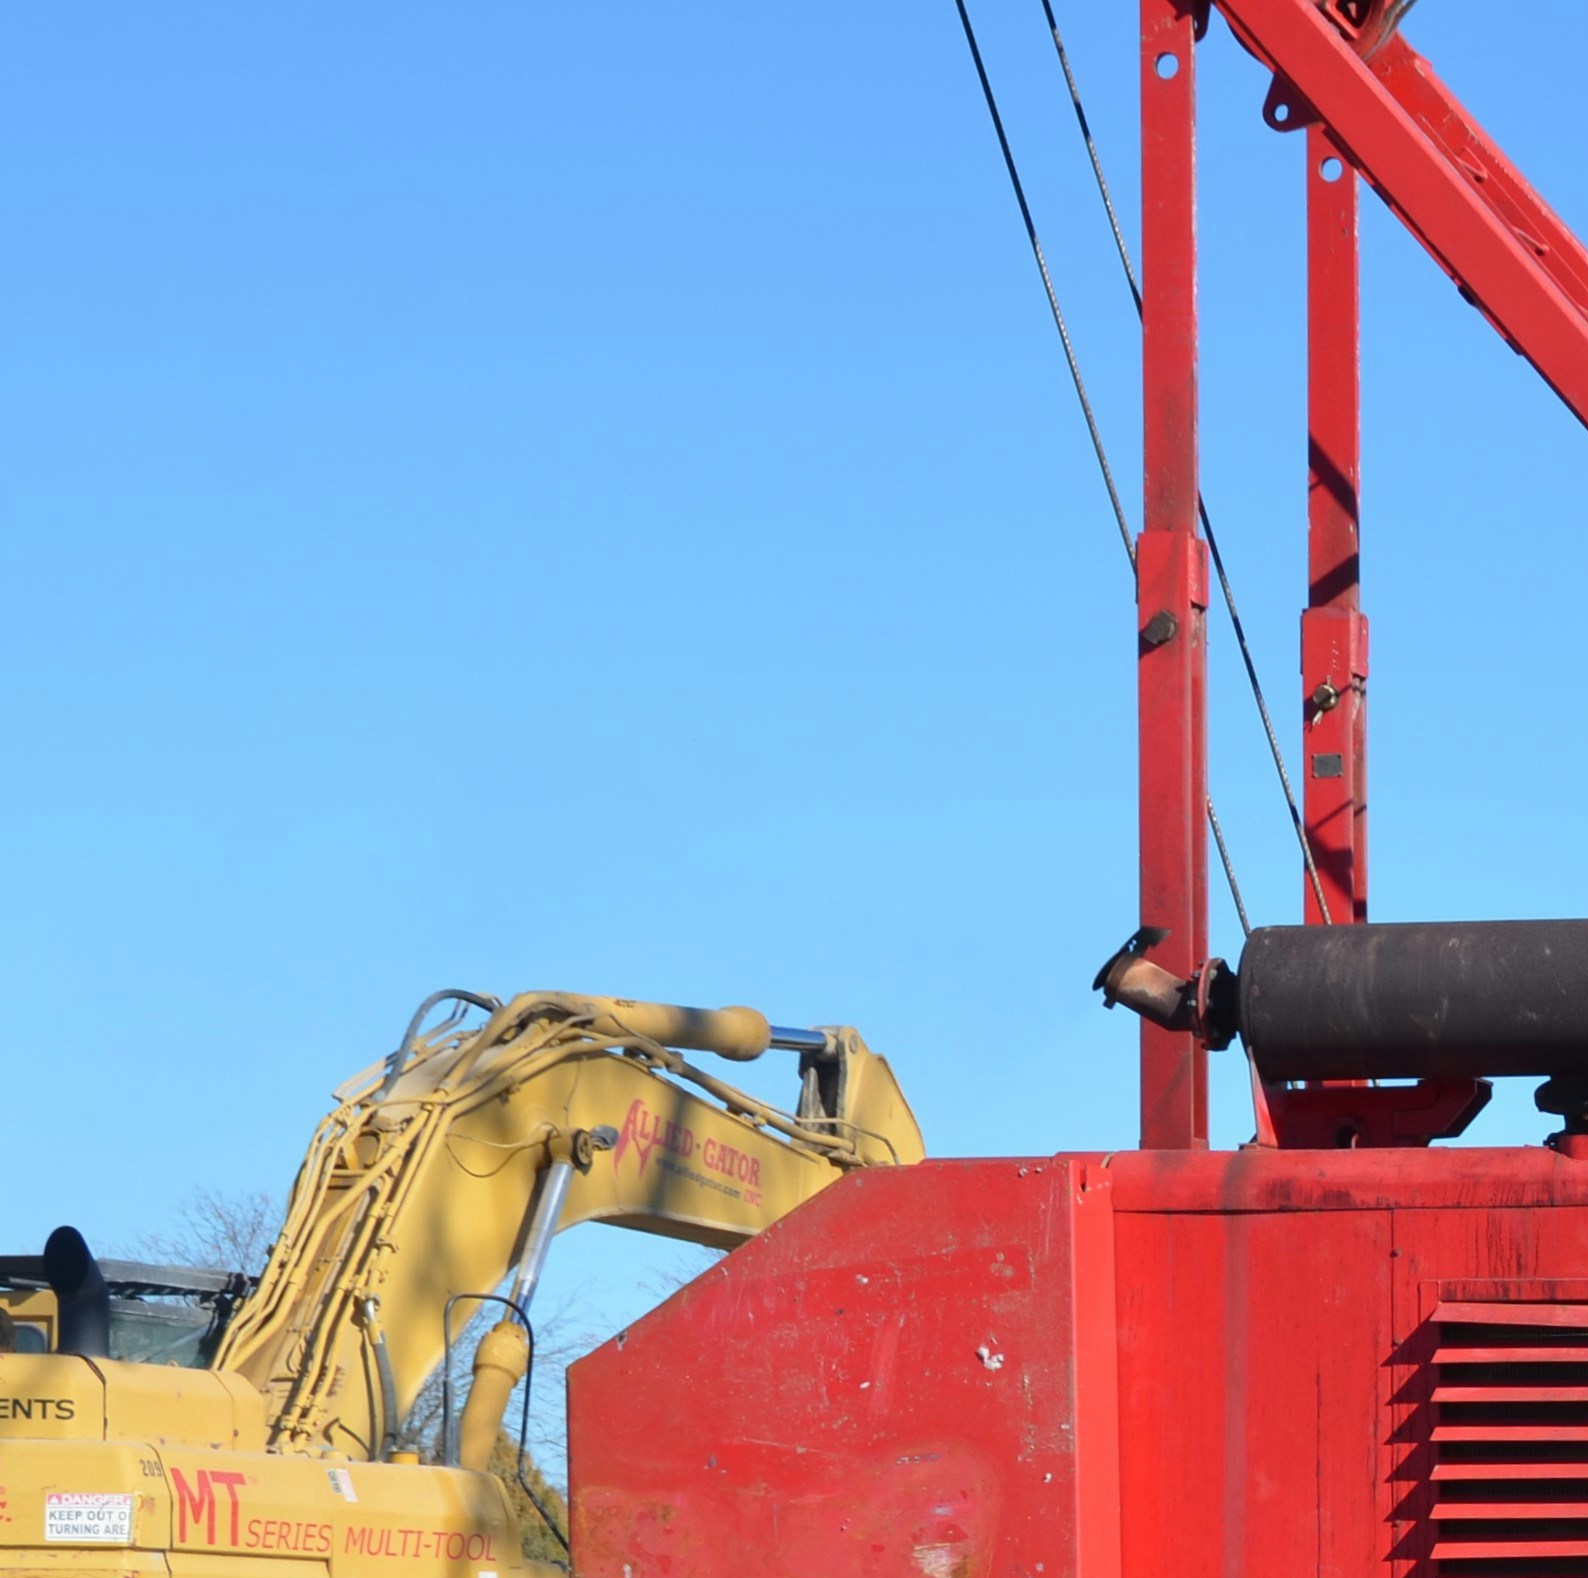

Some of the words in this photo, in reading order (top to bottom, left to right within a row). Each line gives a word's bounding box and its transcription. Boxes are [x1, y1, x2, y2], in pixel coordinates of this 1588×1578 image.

[613, 1098, 694, 1178] ALLIED
[703, 1138, 761, 1187] GATOR
[49, 1510, 82, 1521] KEEP
[87, 1511, 114, 1521] OUT
[49, 1524, 100, 1535] TURNING
[104, 1525, 130, 1535] ARE
[170, 1468, 246, 1546] MT
[245, 1519, 332, 1553] SERIES
[344, 1526, 497, 1562] MULTI-TOOL
